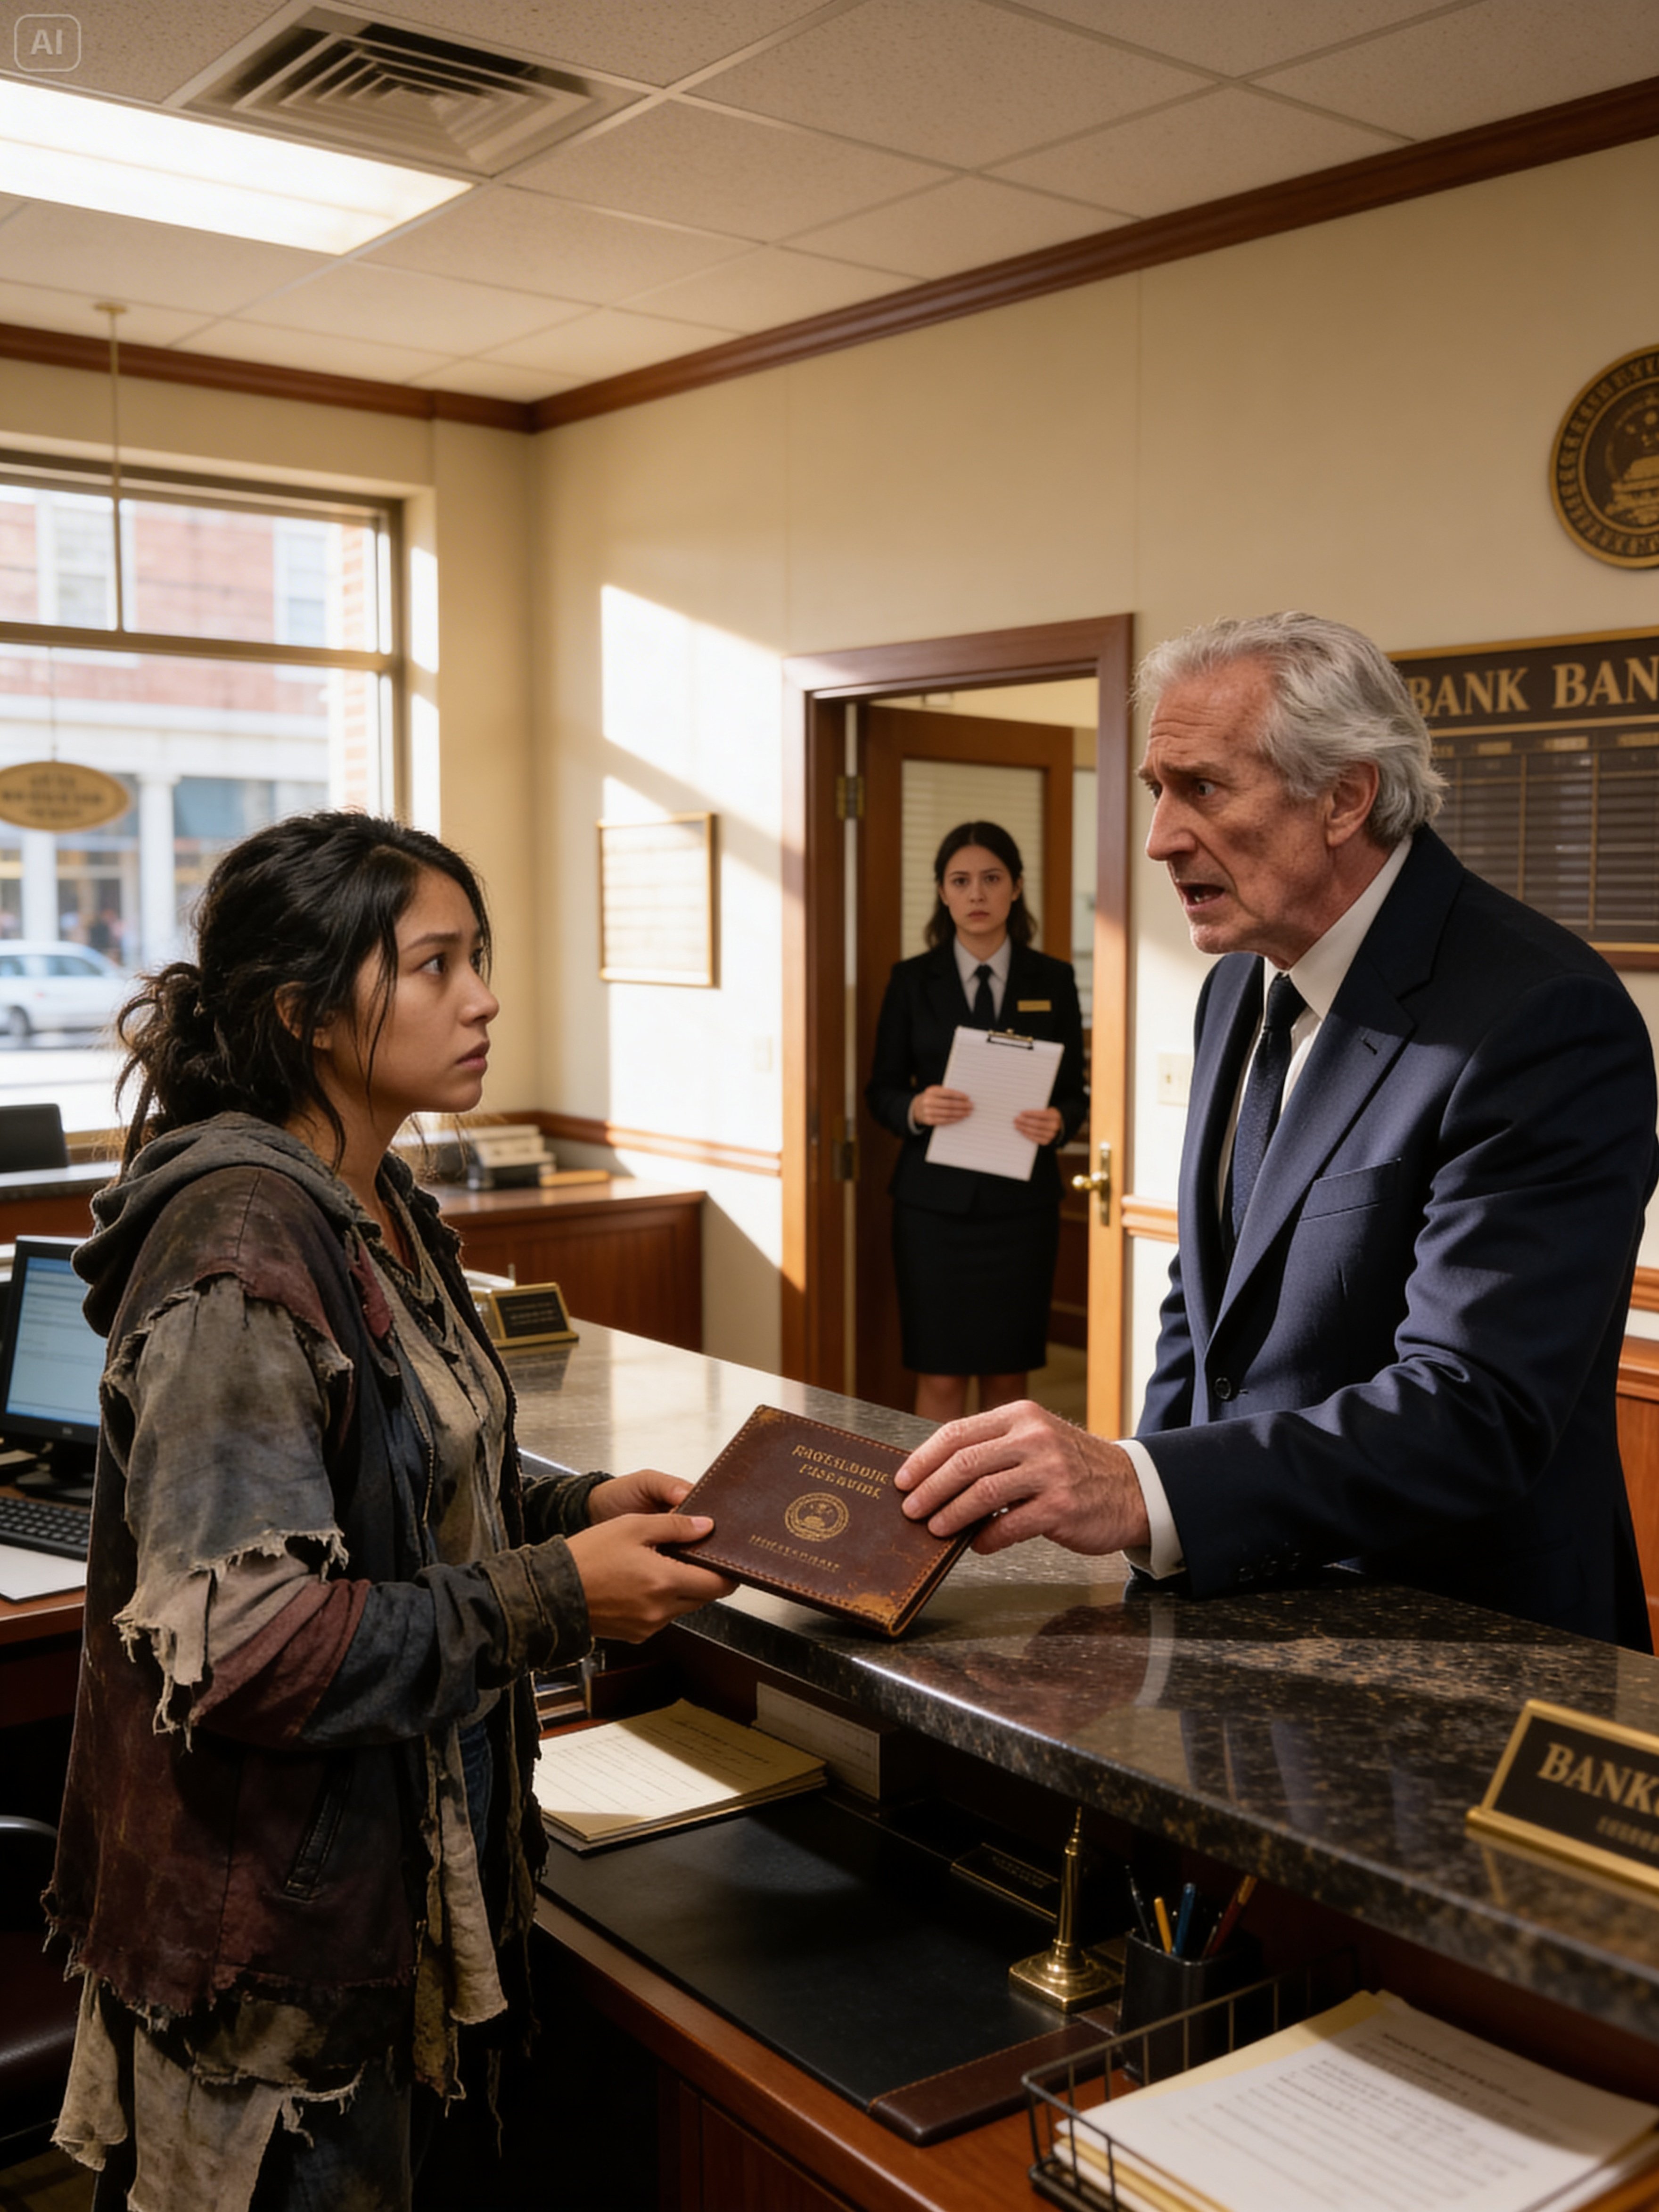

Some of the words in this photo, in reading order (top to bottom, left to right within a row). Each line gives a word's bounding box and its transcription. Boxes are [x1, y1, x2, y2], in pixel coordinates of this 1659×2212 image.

[1406, 667, 1530, 717] BANK
[1552, 654, 1659, 709] BAN
[1536, 1742, 1659, 1818] BANK
